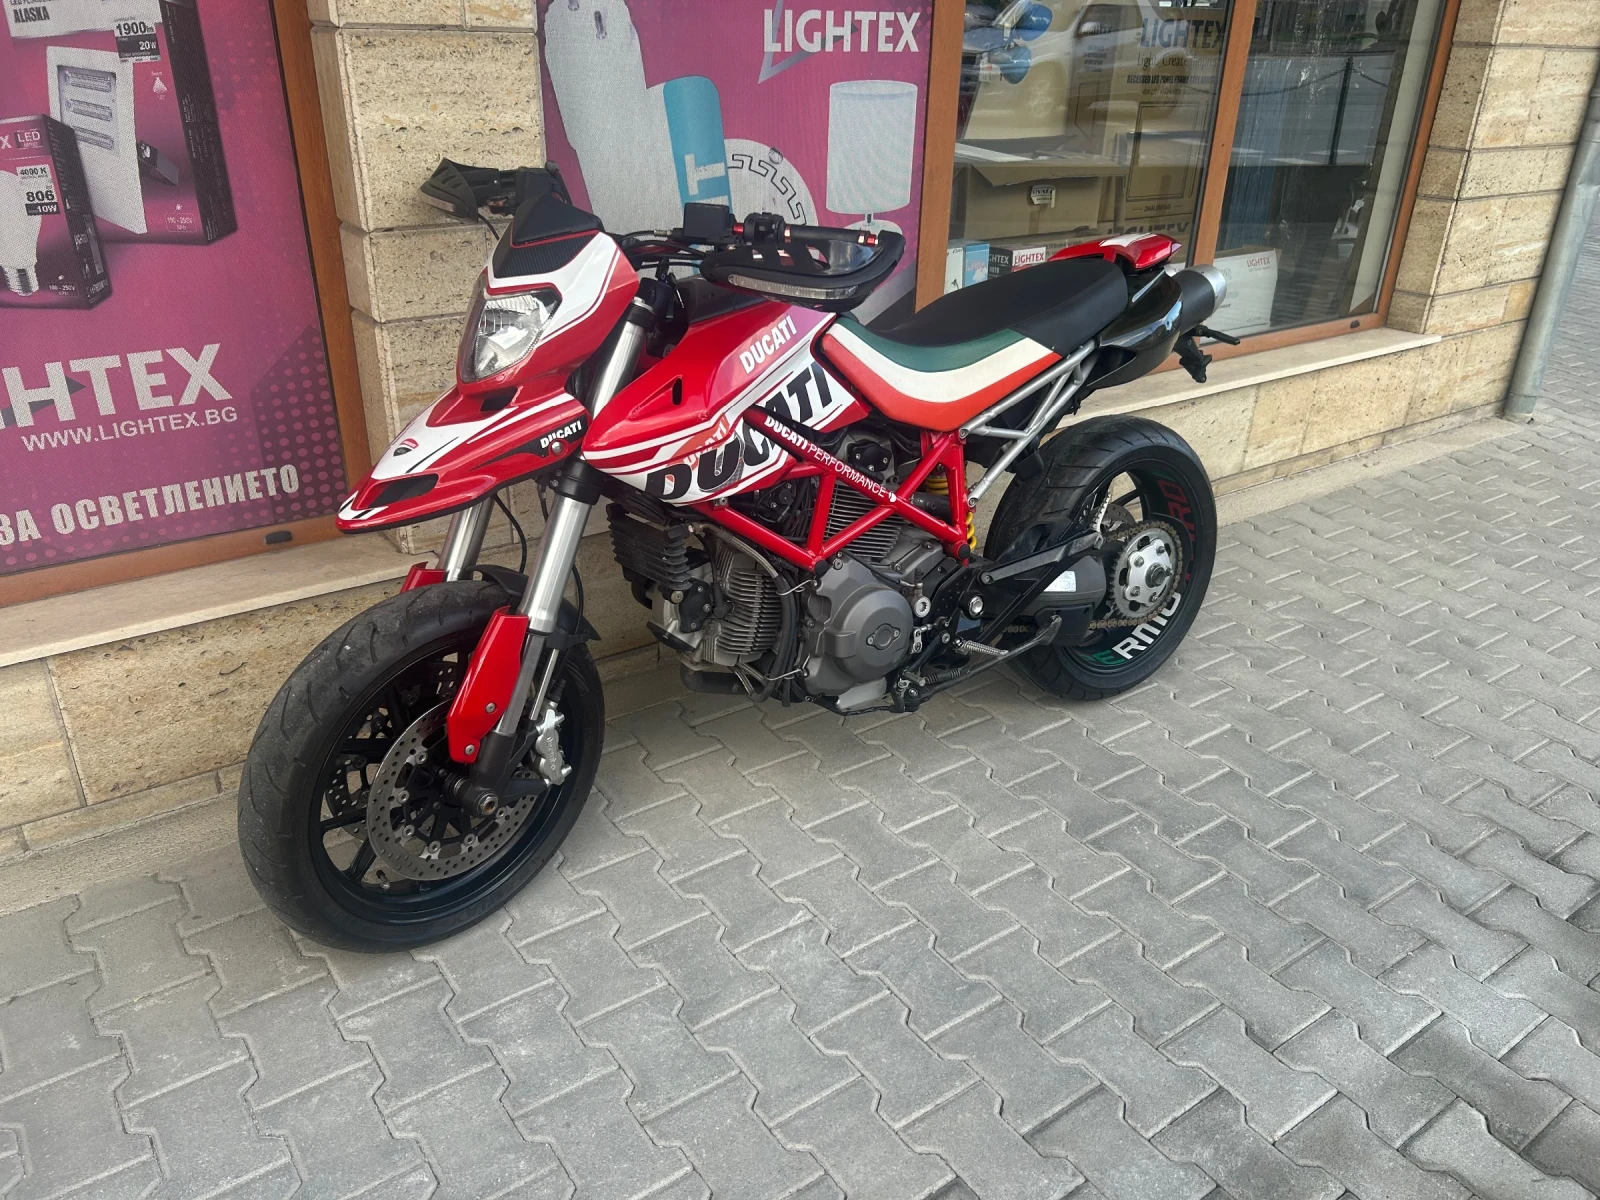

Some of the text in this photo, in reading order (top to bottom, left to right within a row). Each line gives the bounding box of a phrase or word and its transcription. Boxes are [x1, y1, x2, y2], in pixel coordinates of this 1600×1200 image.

[13, 6, 50, 23] ALASKA
[116, 21, 147, 36] 1900
[764, 9, 919, 53] LIGHTEX
[1140, 18, 1224, 48] LIGHTEX
[17, 131, 40, 142] LED
[26, 190, 55, 202] 806
[36, 204, 57, 213] 10W
[1014, 252, 1045, 265] LIGHTEX
[1246, 257, 1271, 267] LIGHTEX
[739, 315, 798, 375] DUCATI
[0, 343, 233, 430] HTEX
[21, 406, 238, 452] WWW.LIGHTEX.BG
[540, 420, 583, 449] DUCATI
[763, 414, 888, 498] DUCATI PERFORMANCE
[50, 463, 300, 535] ОСВЕТЛЕНИЕТО
